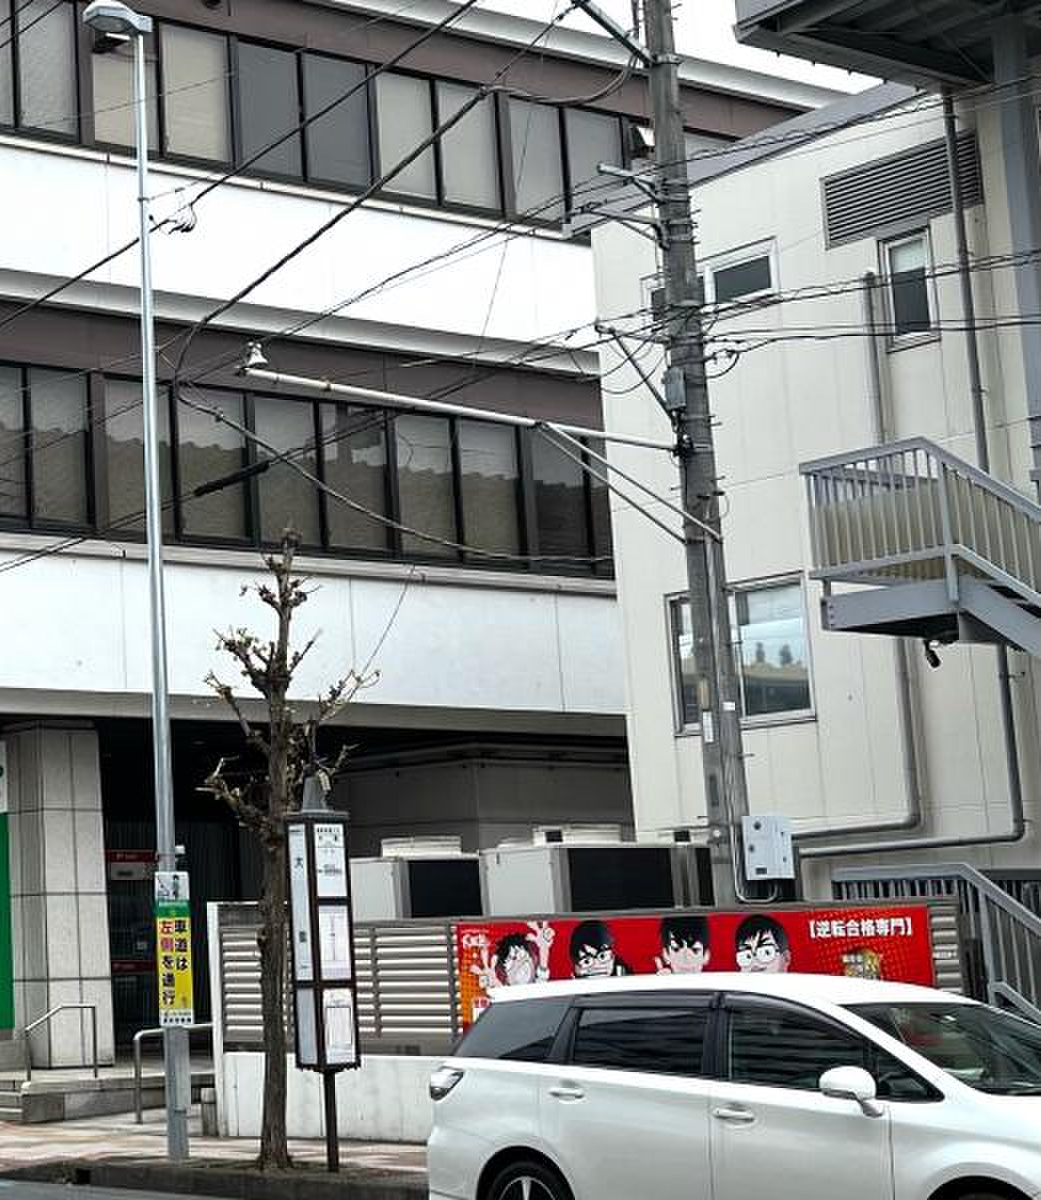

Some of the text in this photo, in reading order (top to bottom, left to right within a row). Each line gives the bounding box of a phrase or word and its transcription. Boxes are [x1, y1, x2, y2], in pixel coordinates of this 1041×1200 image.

[160, 920, 176, 1006] 左側を通行
[175, 919, 188, 971] 車道は
